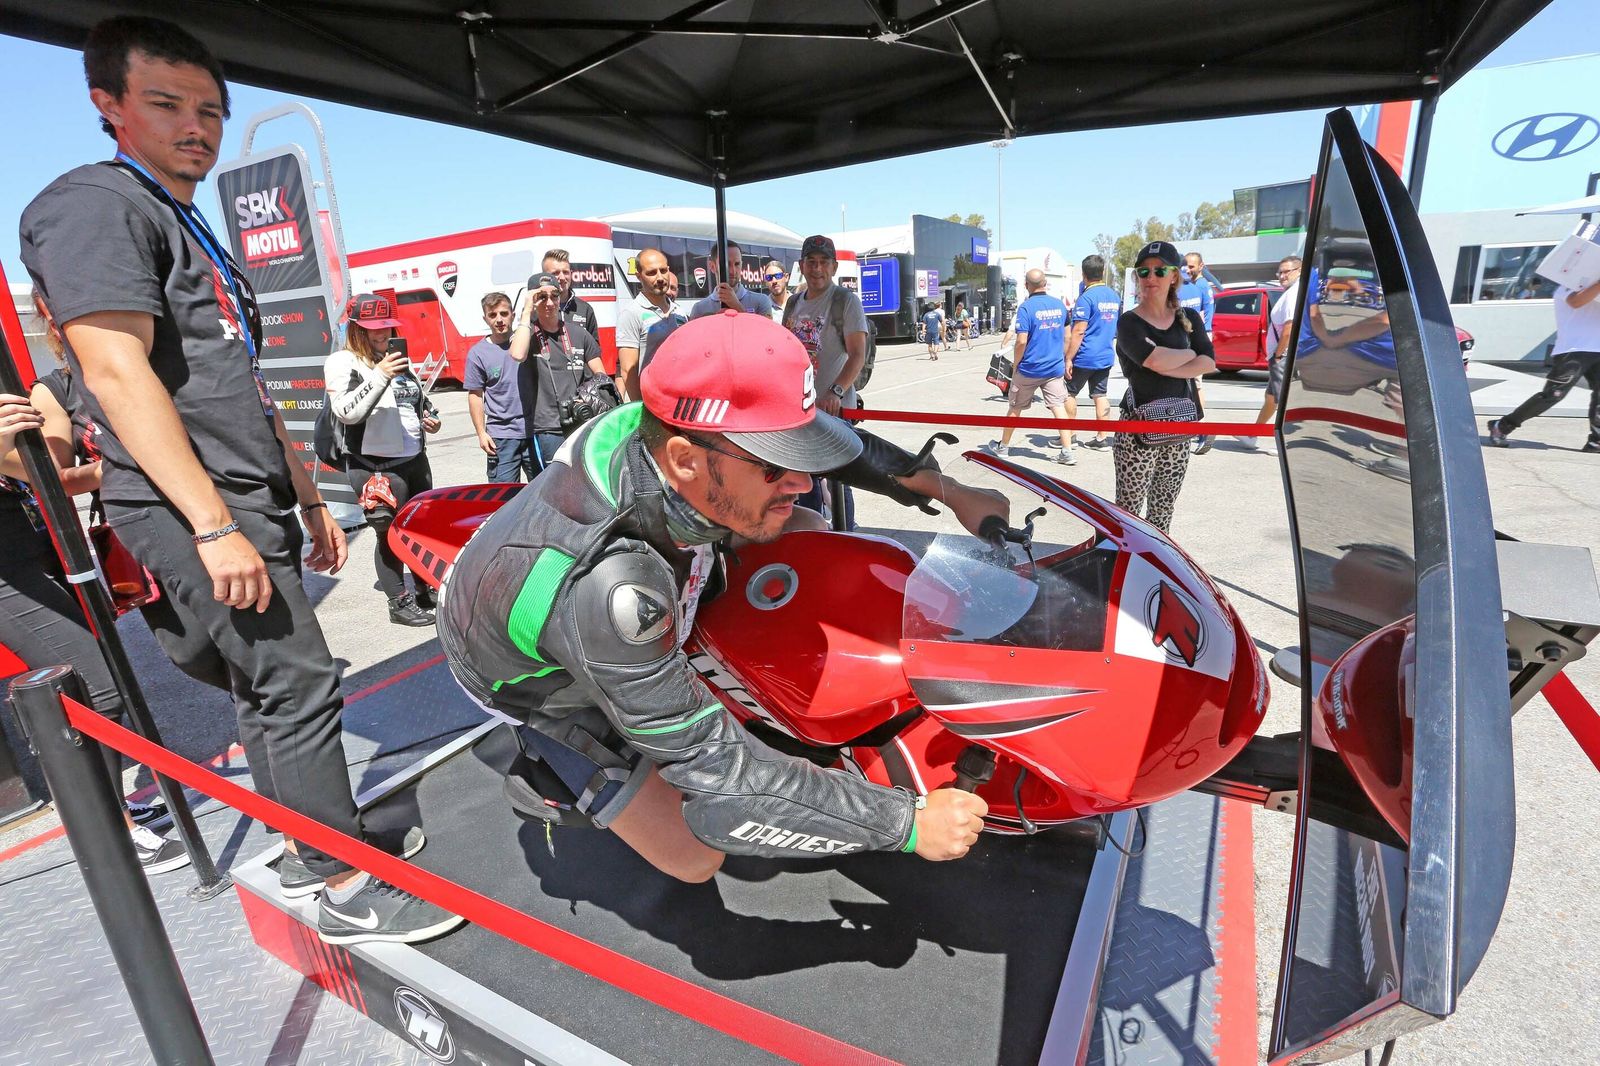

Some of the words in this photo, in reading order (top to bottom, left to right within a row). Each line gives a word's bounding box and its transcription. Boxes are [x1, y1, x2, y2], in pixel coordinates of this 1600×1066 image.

[246, 226, 299, 257] MOTUL
[571, 264, 612, 283] aruba.it
[360, 299, 390, 319] 93
[297, 399, 324, 410] LOUNGE
[729, 820, 863, 855] DAINESE
